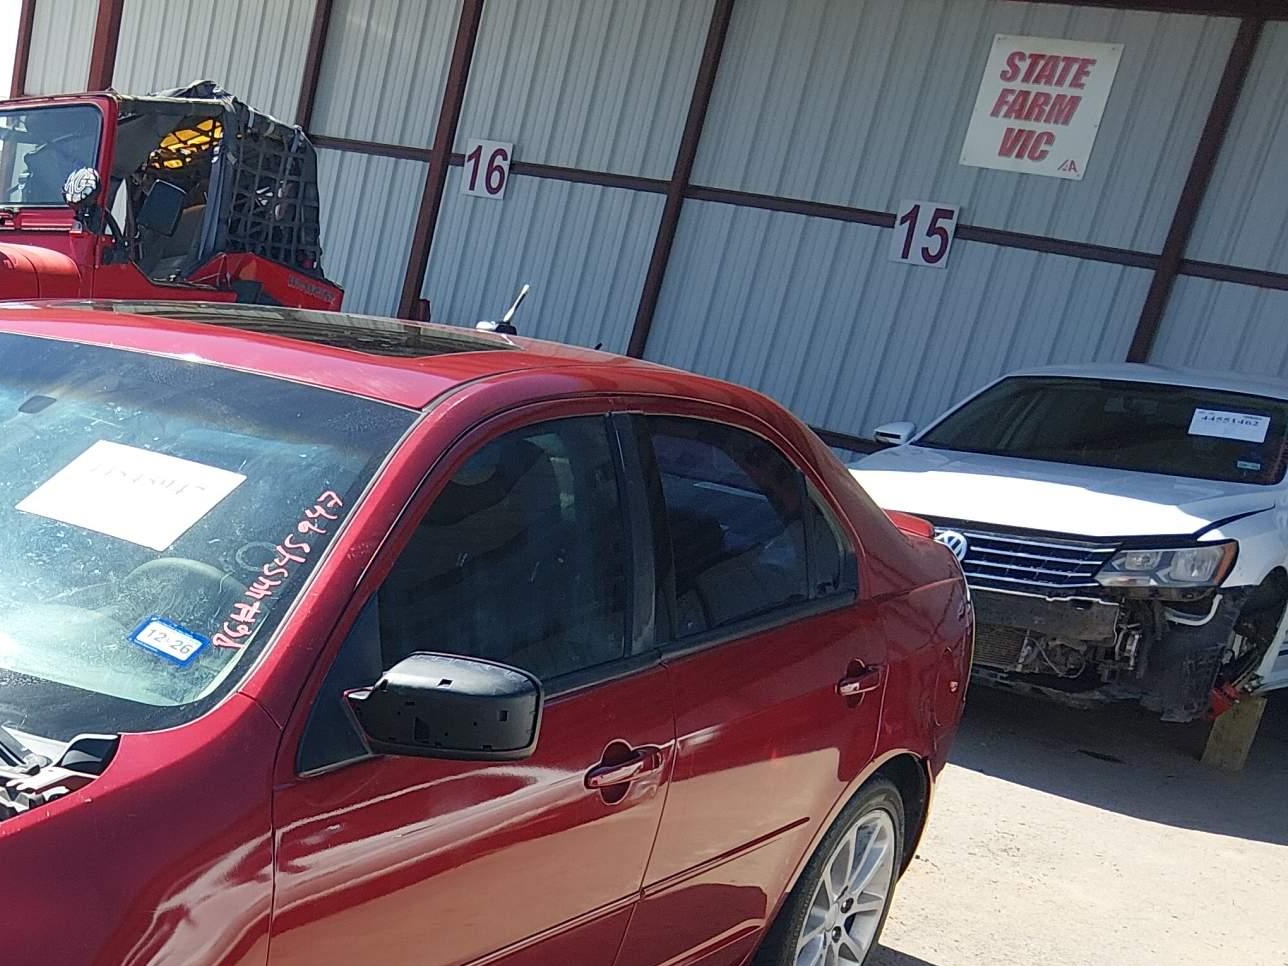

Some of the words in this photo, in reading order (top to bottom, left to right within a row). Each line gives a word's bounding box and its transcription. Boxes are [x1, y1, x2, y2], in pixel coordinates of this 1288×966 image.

[999, 51, 1097, 90] STATE
[990, 88, 1082, 126] FARM
[998, 127, 1056, 162] VIC
[466, 144, 509, 196] 16
[899, 204, 955, 264] 15
